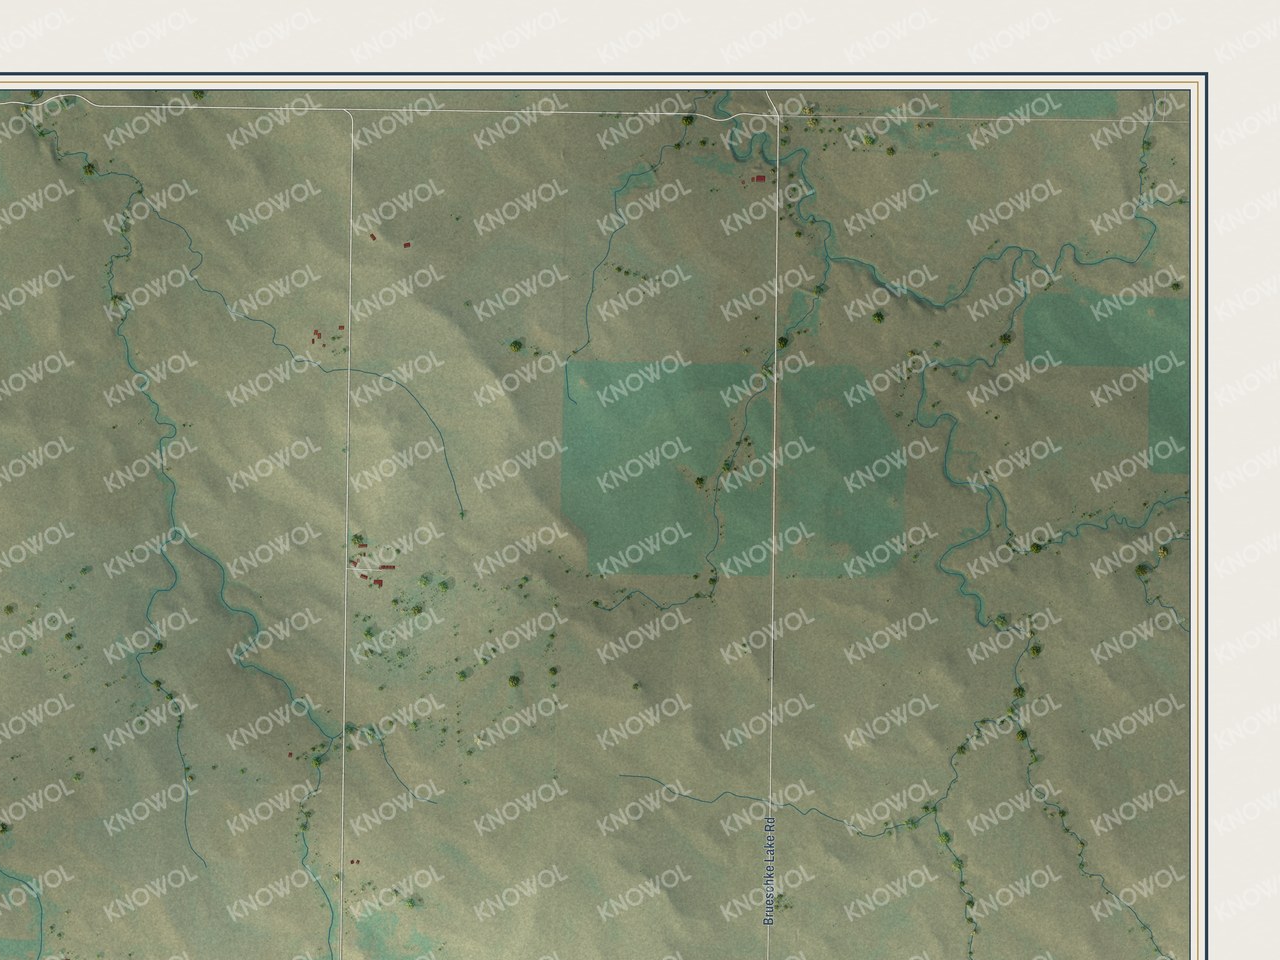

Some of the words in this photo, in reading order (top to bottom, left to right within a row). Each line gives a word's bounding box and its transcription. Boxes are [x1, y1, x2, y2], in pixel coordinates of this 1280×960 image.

[764, 817, 775, 832] Rd
[764, 835, 775, 862] Lake
[763, 865, 774, 925] Brueschke
